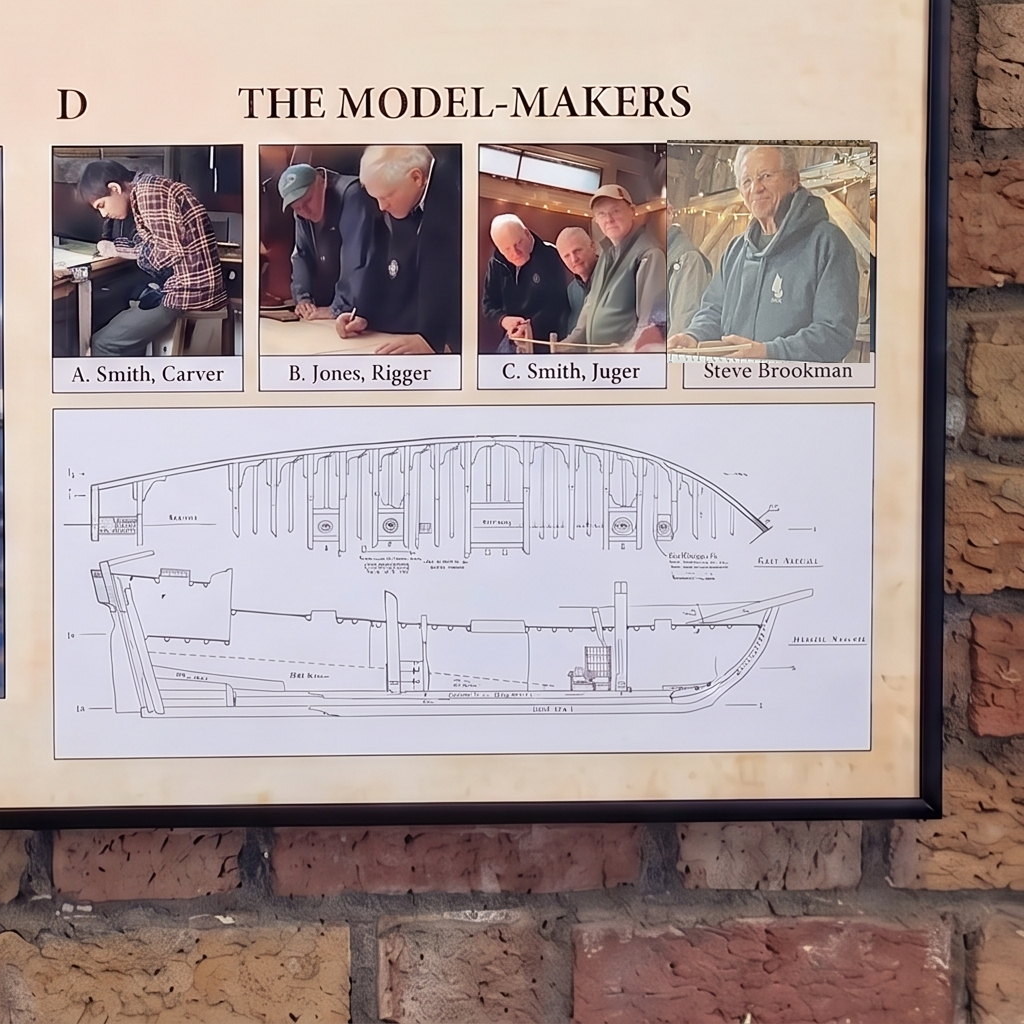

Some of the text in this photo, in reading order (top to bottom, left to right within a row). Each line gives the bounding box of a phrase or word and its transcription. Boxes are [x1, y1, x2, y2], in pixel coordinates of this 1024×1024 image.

[56, 88, 88, 120] D
[237, 85, 691, 120] THE MODEL-MAKERS
[71, 364, 225, 385] A. Smith, Carver
[289, 364, 432, 387] B. Jones, Rigger
[502, 361, 641, 385] C. Smith, Juger
[703, 362, 853, 379] Steve Brookman
